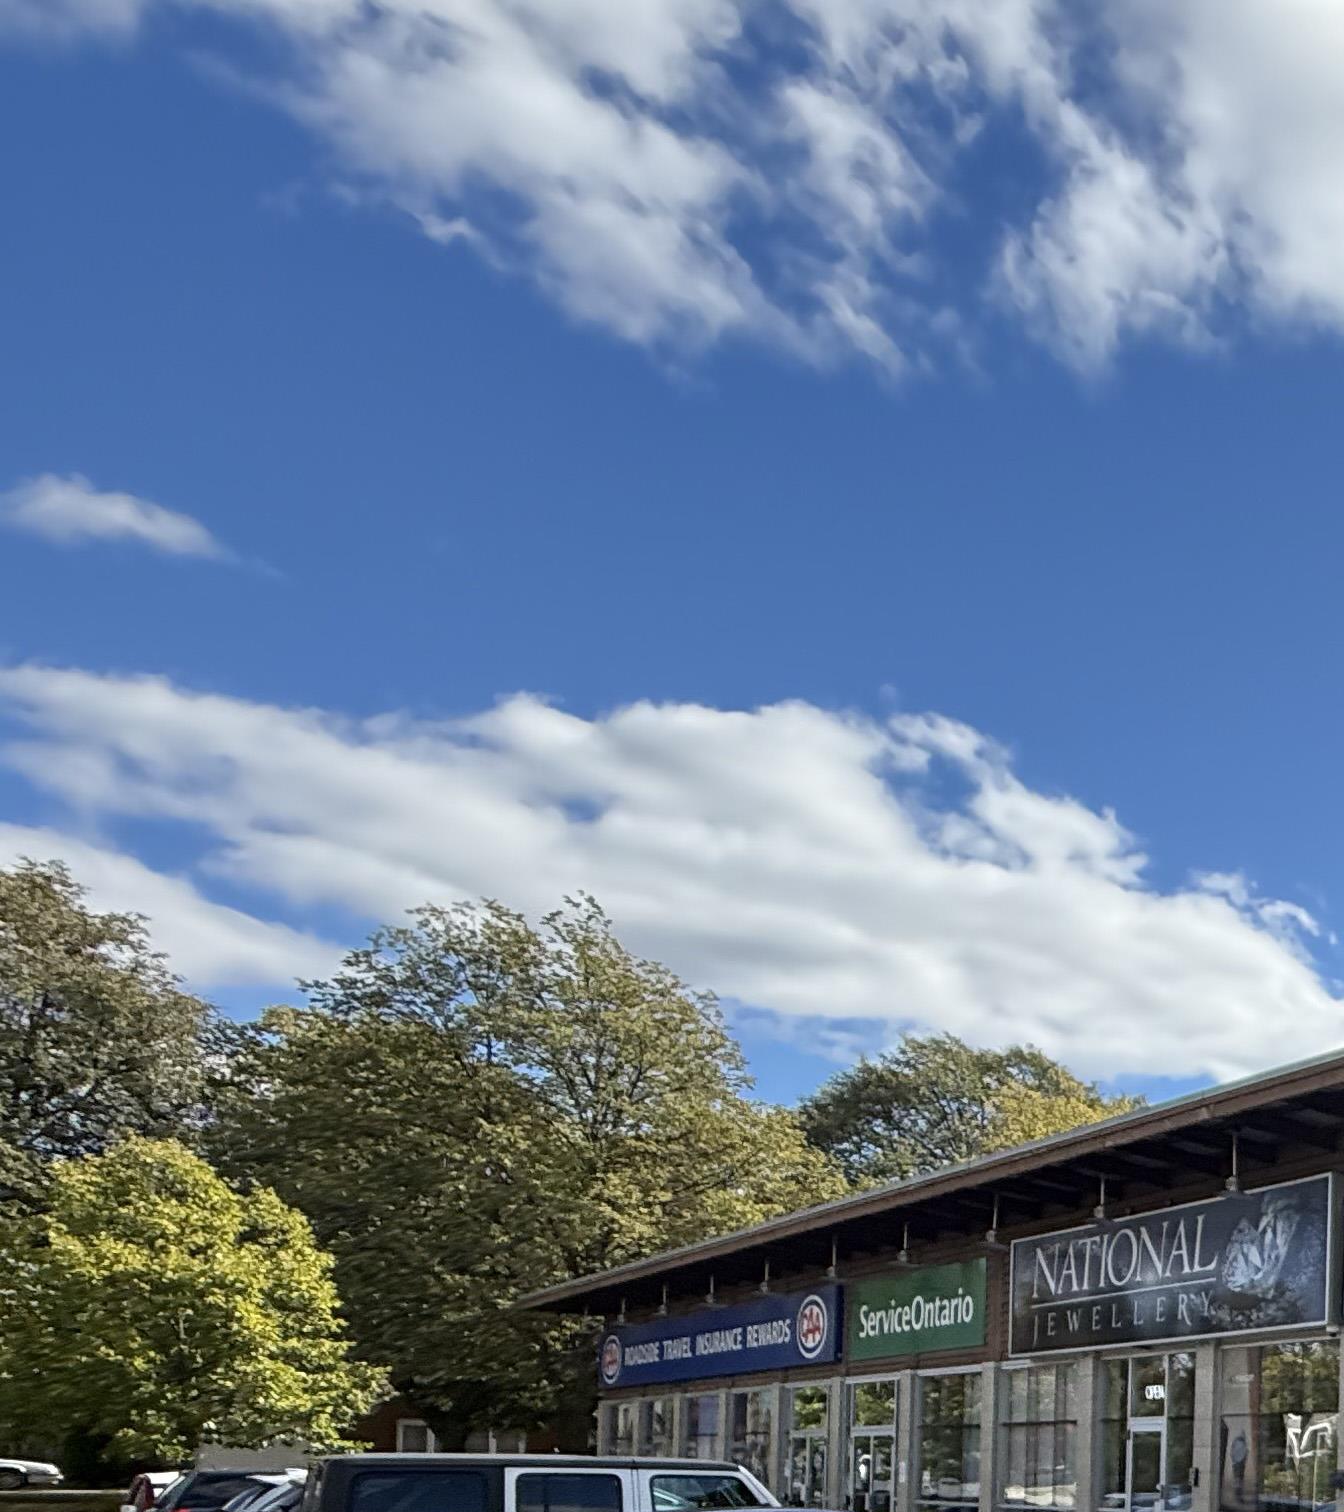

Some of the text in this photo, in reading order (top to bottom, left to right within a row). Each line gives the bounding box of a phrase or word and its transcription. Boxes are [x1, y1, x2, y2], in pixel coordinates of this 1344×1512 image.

[1031, 1214, 1218, 1298] NATIONAL
[859, 1287, 974, 1338] ServiceOntario
[1032, 1291, 1216, 1347] JEWELLERY
[624, 1319, 791, 1366] ROADSIDE TRAVEL INSURANCE REWARDS
